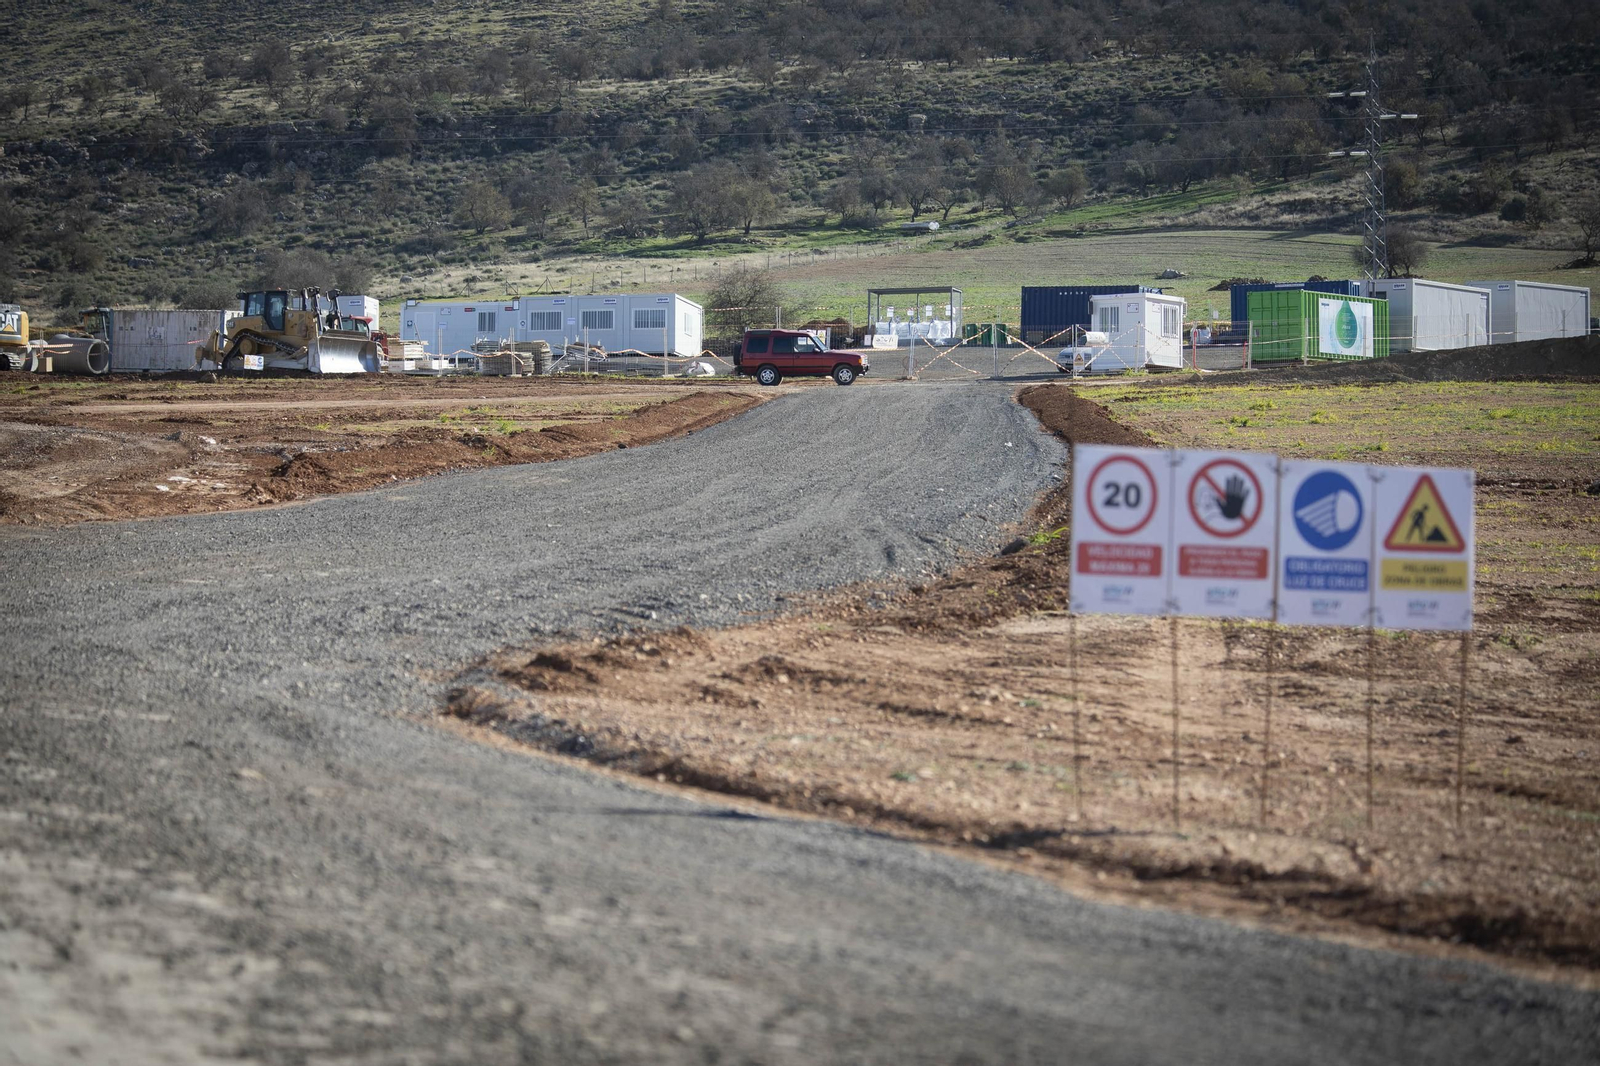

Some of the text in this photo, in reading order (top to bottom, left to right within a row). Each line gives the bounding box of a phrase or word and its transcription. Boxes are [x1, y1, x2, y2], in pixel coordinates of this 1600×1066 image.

[0, 313, 19, 332] CAT
[1104, 481, 1142, 508] 20
[1290, 560, 1364, 574] OBLIGATORIO
